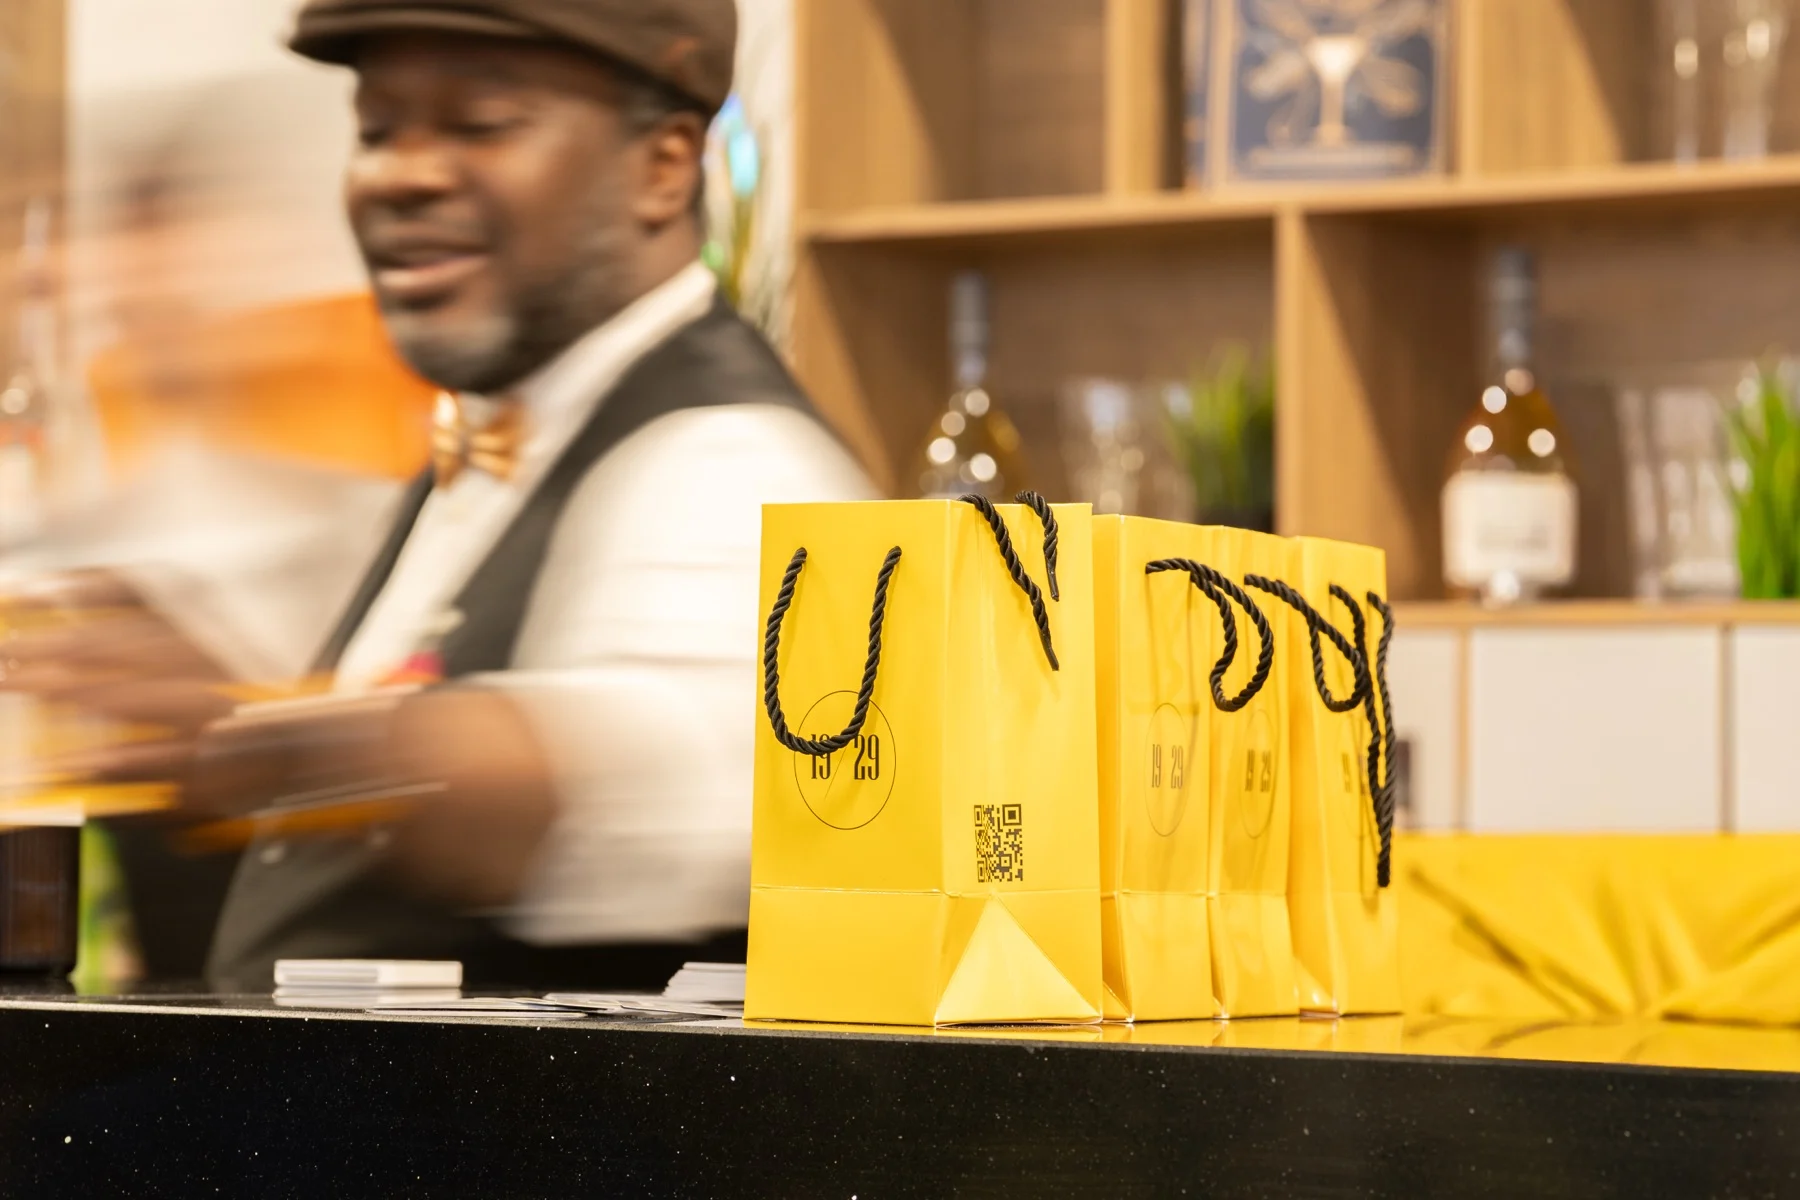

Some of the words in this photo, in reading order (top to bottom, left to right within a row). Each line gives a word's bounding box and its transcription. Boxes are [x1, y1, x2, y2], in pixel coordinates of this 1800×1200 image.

[811, 733, 831, 780] 19
[854, 734, 879, 780] 29
[1152, 743, 1162, 788] 19
[1171, 744, 1184, 789] 29
